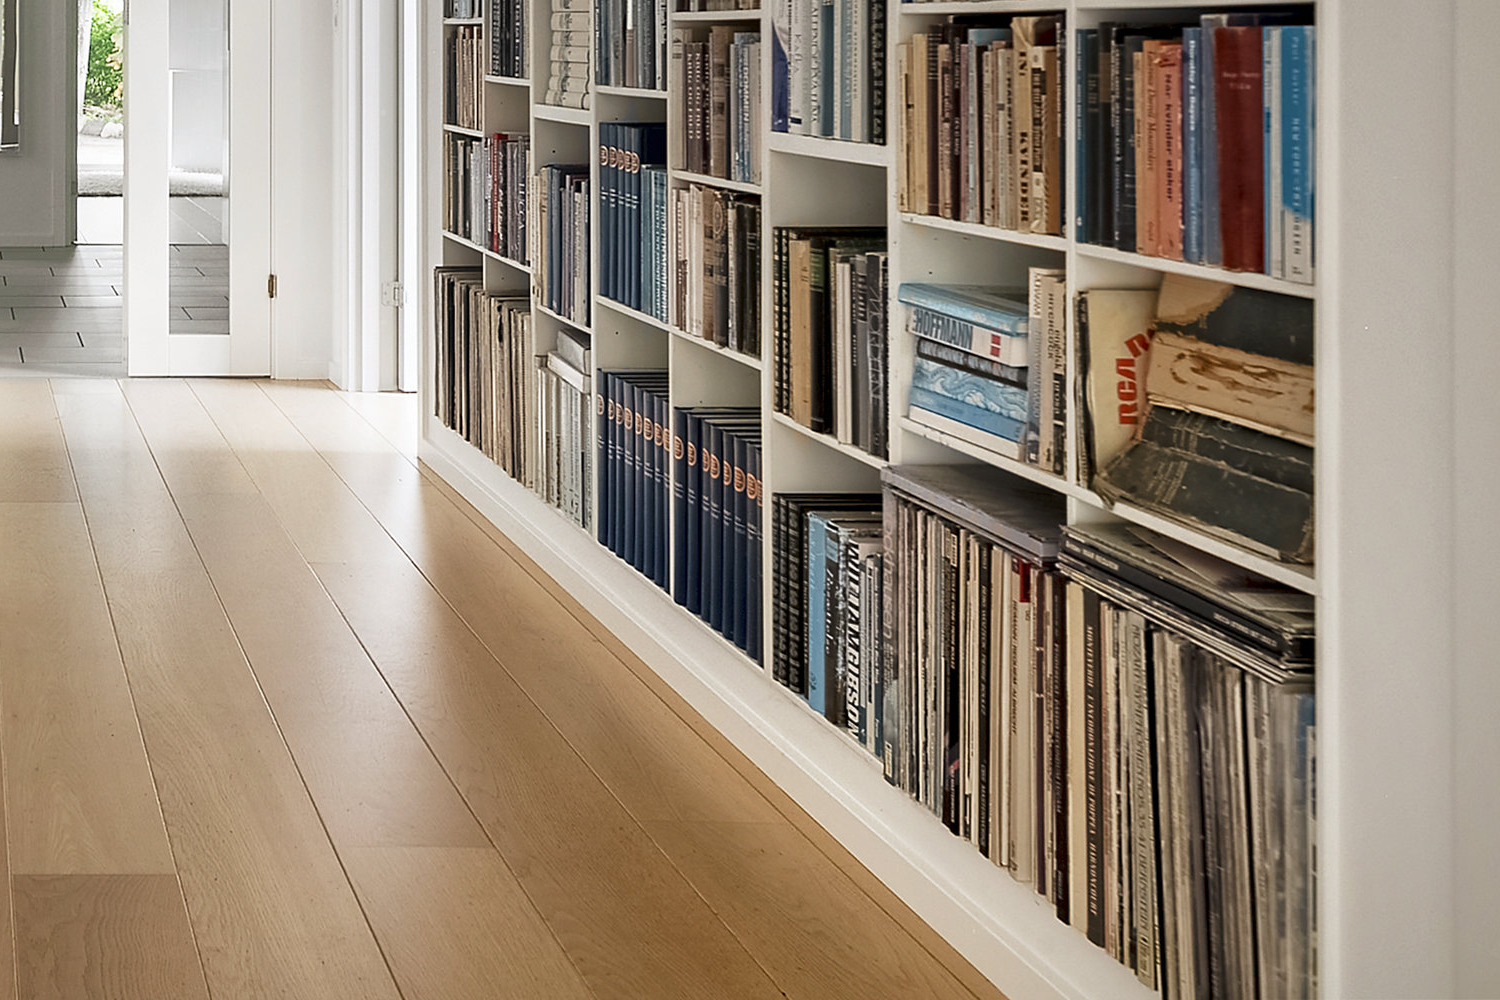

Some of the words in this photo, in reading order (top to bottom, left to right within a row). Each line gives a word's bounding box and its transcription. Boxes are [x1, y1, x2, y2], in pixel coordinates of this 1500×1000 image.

[1188, 40, 1197, 83] Dorothy
[1164, 103, 1175, 155] kvinder
[1188, 96, 1197, 132] Sayers
[1291, 118, 1301, 141] NEW
[1019, 131, 1029, 223] KVINDER
[1166, 159, 1176, 203] elsker
[915, 308, 974, 351] HOFFMANN
[1047, 292, 1056, 360] HITCHCOCK
[1052, 329, 1064, 370] engelsk
[1052, 380, 1063, 415] prosa
[1116, 358, 1139, 424] RCA
[847, 538, 861, 648] WILLIAM
[980, 653, 988, 682] PIERRE
[1086, 624, 1094, 687] MONTEVERDI
[847, 646, 861, 740] GIBSON
[980, 682, 988, 716] BOULEZ
[1133, 625, 1145, 681] MOZART
[1139, 852, 1150, 930] BERNSTEIN
[1089, 796, 1097, 834] POPPEA
[1090, 841, 1098, 916] HARNONCOURT
